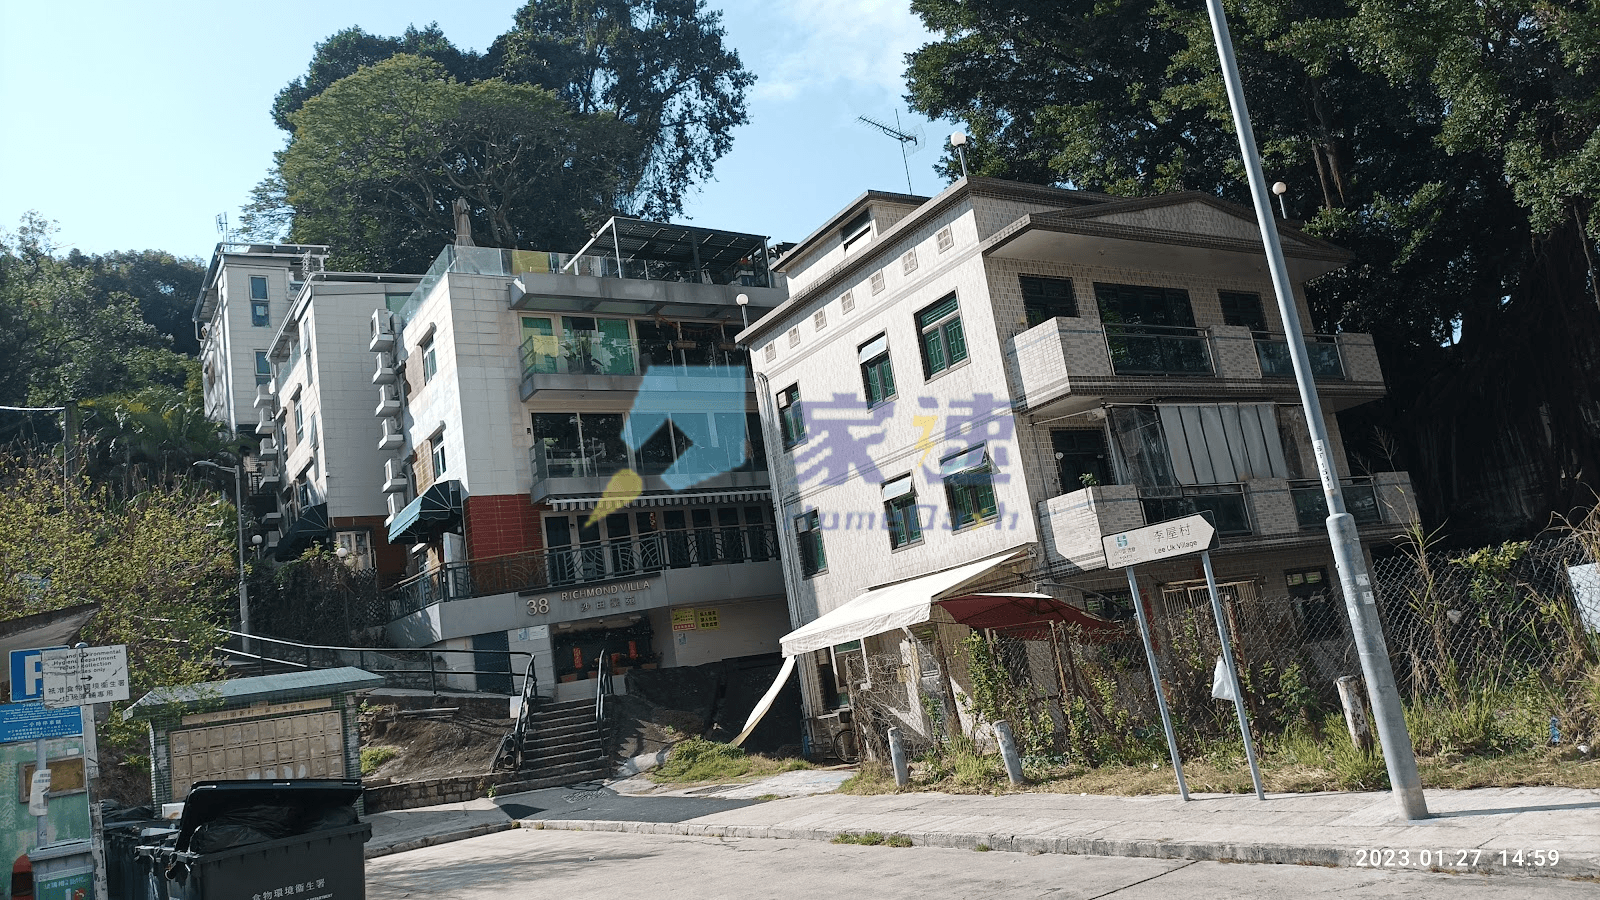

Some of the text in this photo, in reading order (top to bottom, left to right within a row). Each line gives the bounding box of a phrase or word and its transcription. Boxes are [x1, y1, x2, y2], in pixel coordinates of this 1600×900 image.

[1153, 523, 1191, 542] 李屋村
[1176, 540, 1198, 550] Village
[561, 580, 651, 601] RICHMOND VILLA
[526, 597, 549, 616] 38
[79, 649, 122, 658] Eironmental
